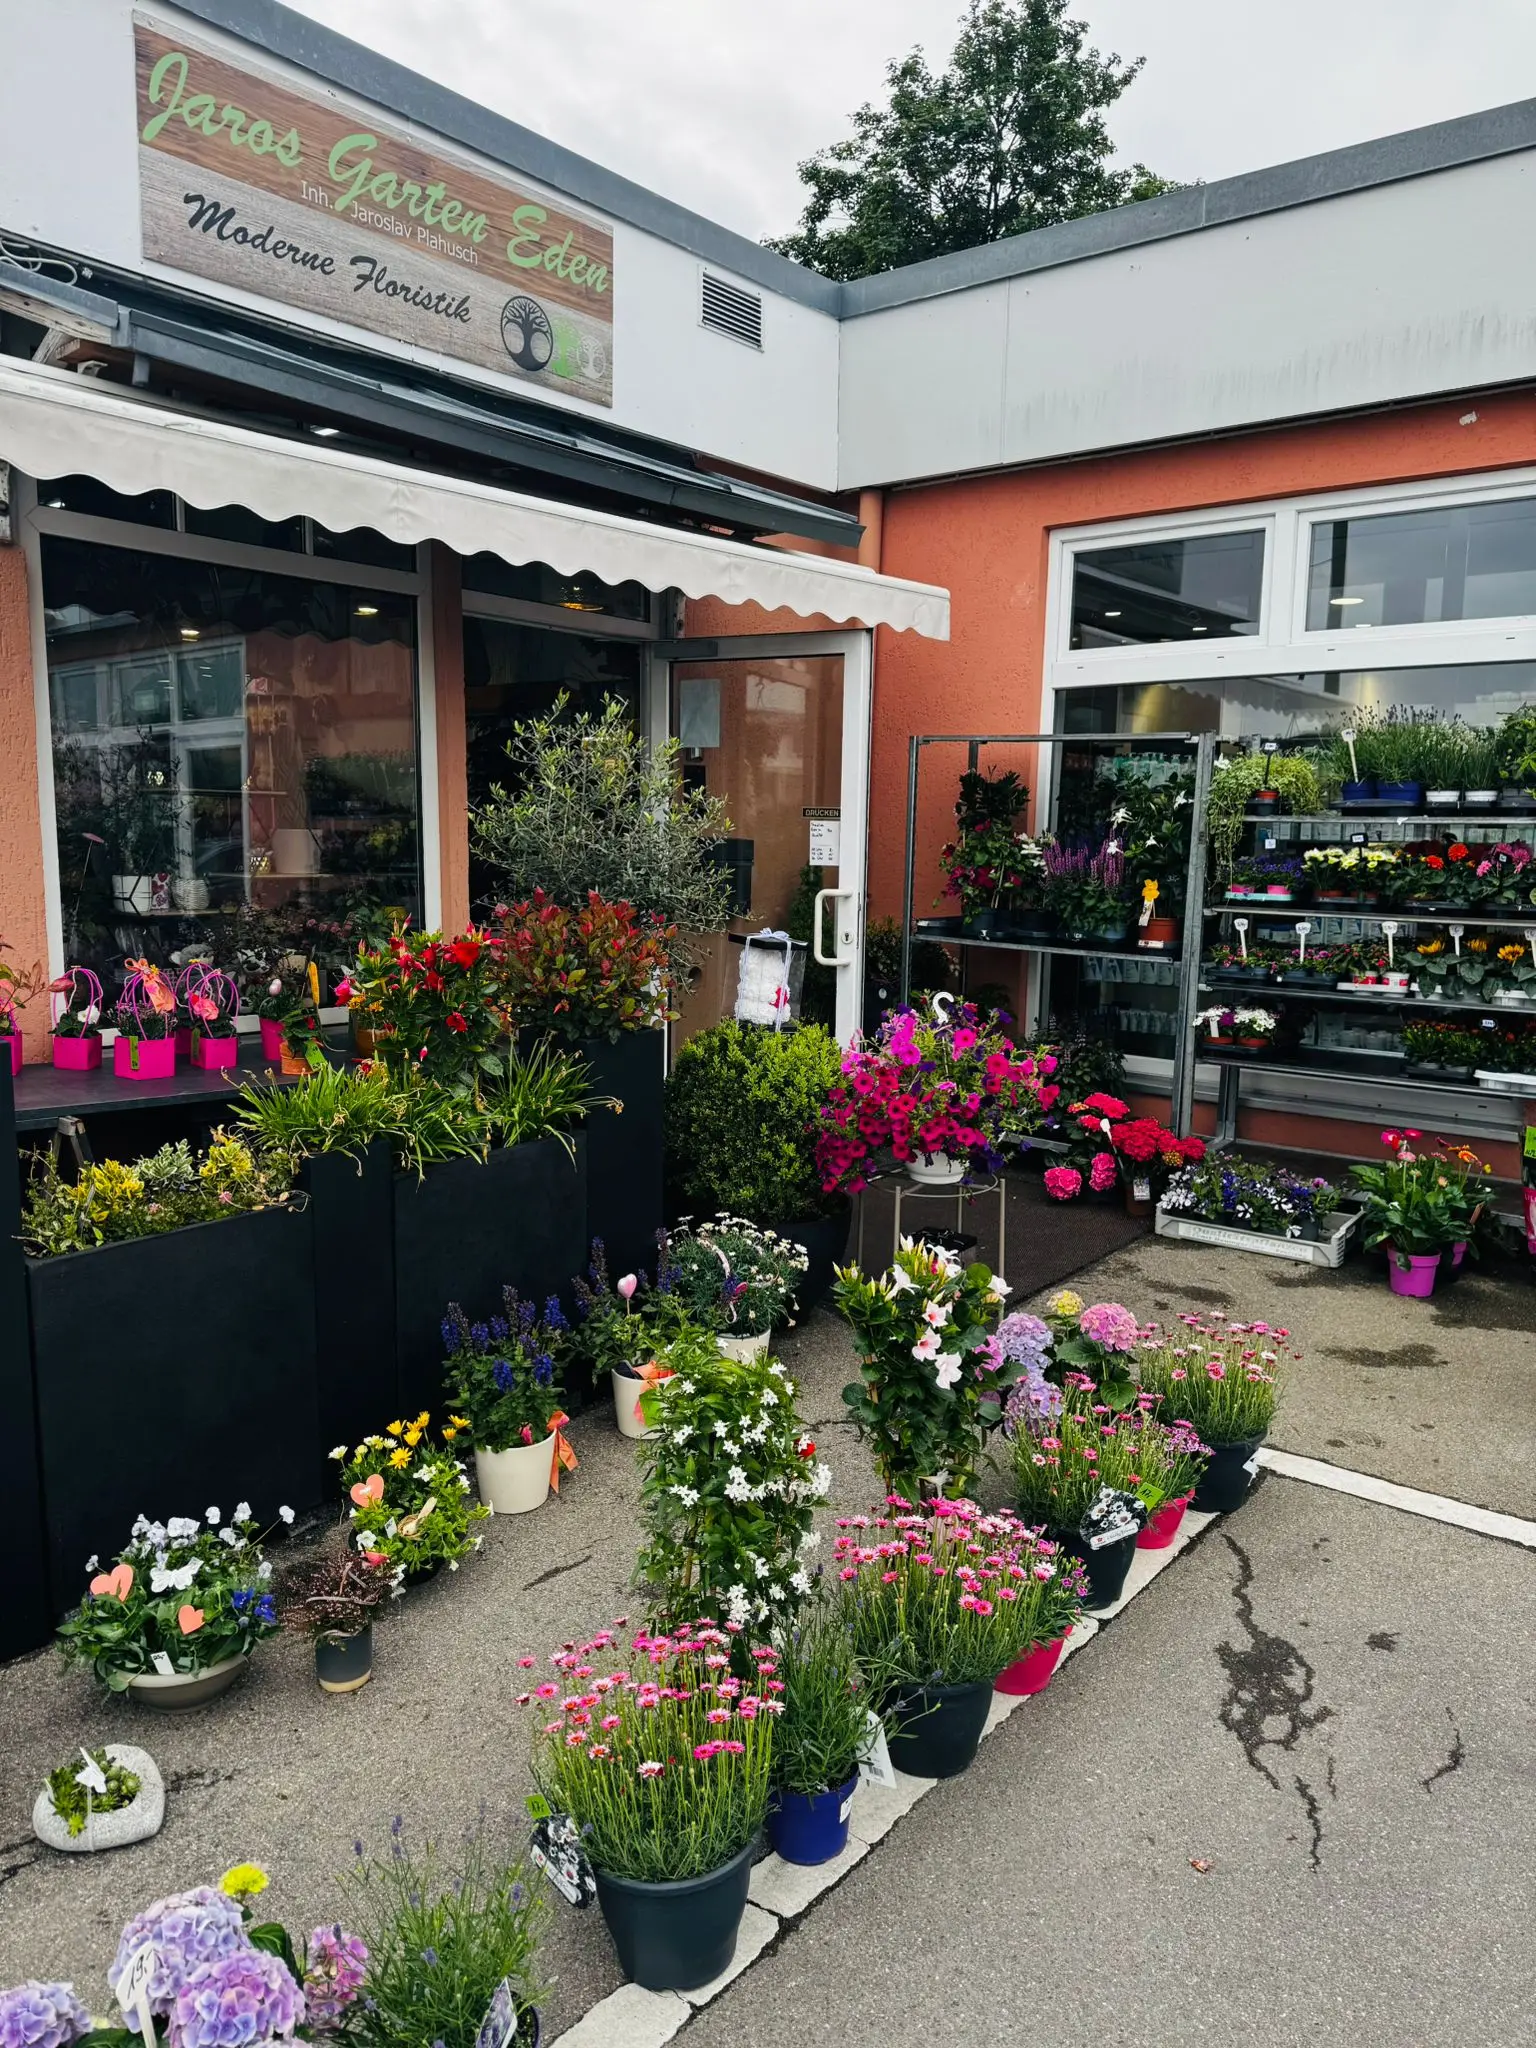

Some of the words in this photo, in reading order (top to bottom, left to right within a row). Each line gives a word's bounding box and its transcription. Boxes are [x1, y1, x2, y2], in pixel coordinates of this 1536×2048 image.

[141, 52, 304, 168] Jaros
[328, 133, 488, 243] Garten
[506, 205, 608, 293] Eden
[300, 180, 334, 210] Inh.
[351, 200, 413, 239] Jaroslav
[417, 226, 478, 265] Plahusch
[184, 194, 336, 276] Moderne
[350, 256, 472, 324] Floristik
